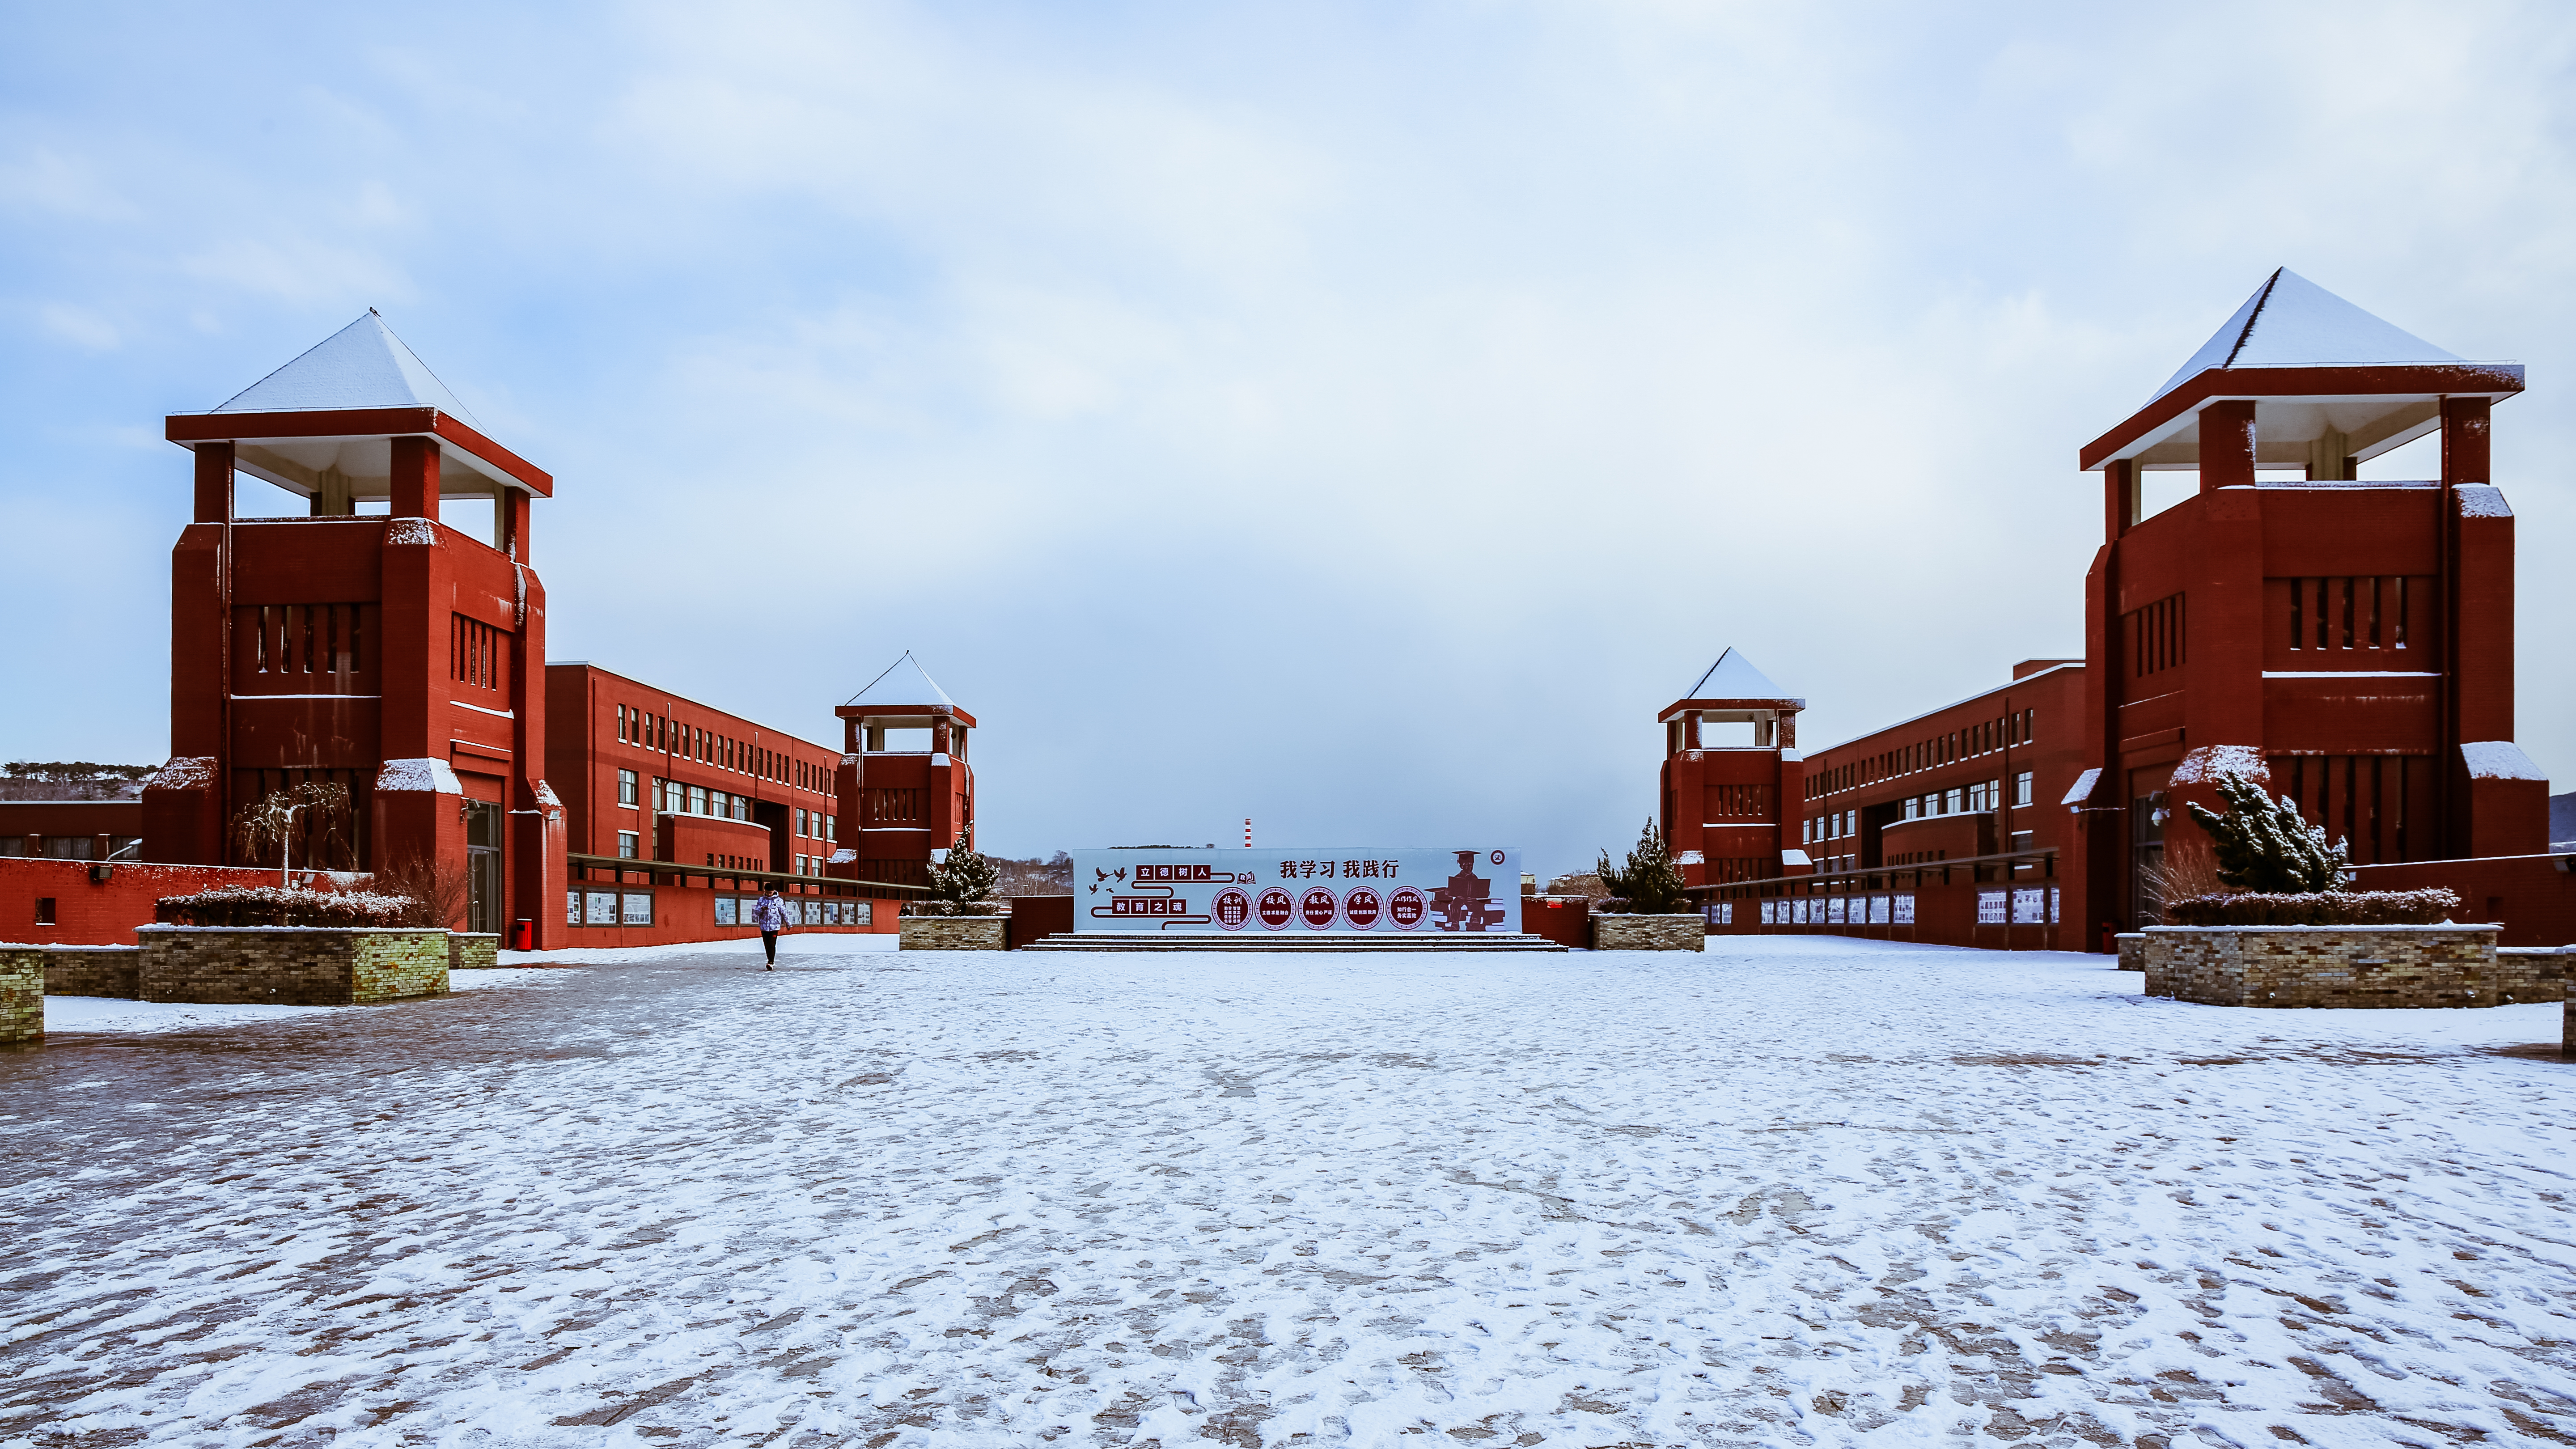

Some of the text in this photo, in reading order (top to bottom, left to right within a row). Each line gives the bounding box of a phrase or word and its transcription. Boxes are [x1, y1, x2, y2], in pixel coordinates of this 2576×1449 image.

[1141, 868, 1206, 877] 立德树人
[1280, 860, 1399, 878] 我学习 我践行
[1223, 895, 1242, 905] 校训
[1266, 895, 1286, 905] 校风
[1309, 895, 1329, 904] 教风
[1354, 895, 1373, 905] 学风
[1117, 902, 1182, 911] 教育之魂
